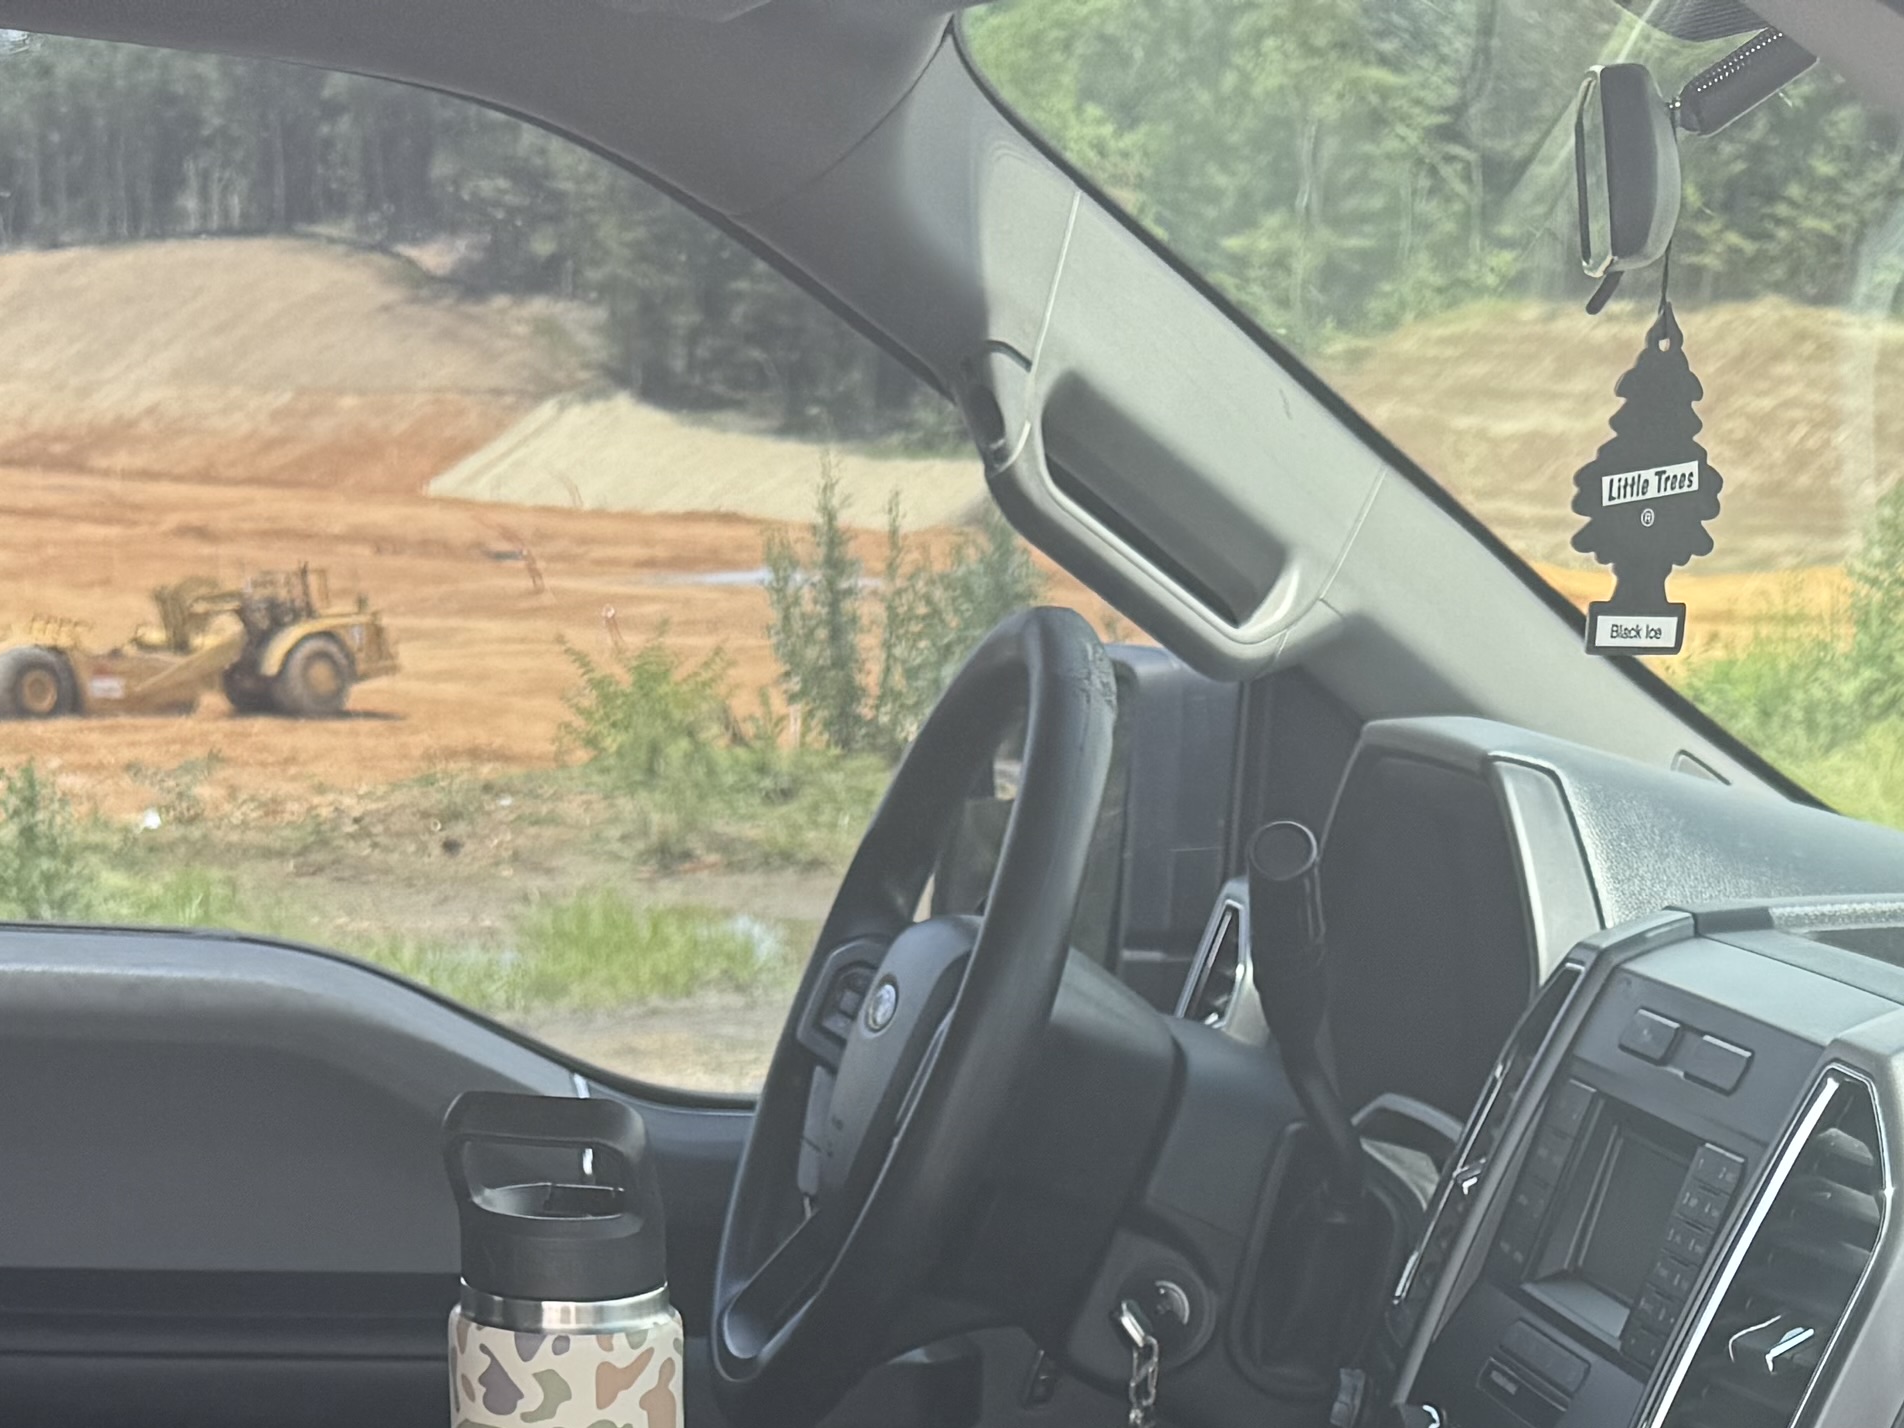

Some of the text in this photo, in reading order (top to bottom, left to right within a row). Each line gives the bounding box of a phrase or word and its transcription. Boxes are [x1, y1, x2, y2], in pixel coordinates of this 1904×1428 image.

[1608, 470, 1693, 501] Little Trees
[1610, 624, 1662, 639] Black Ice
